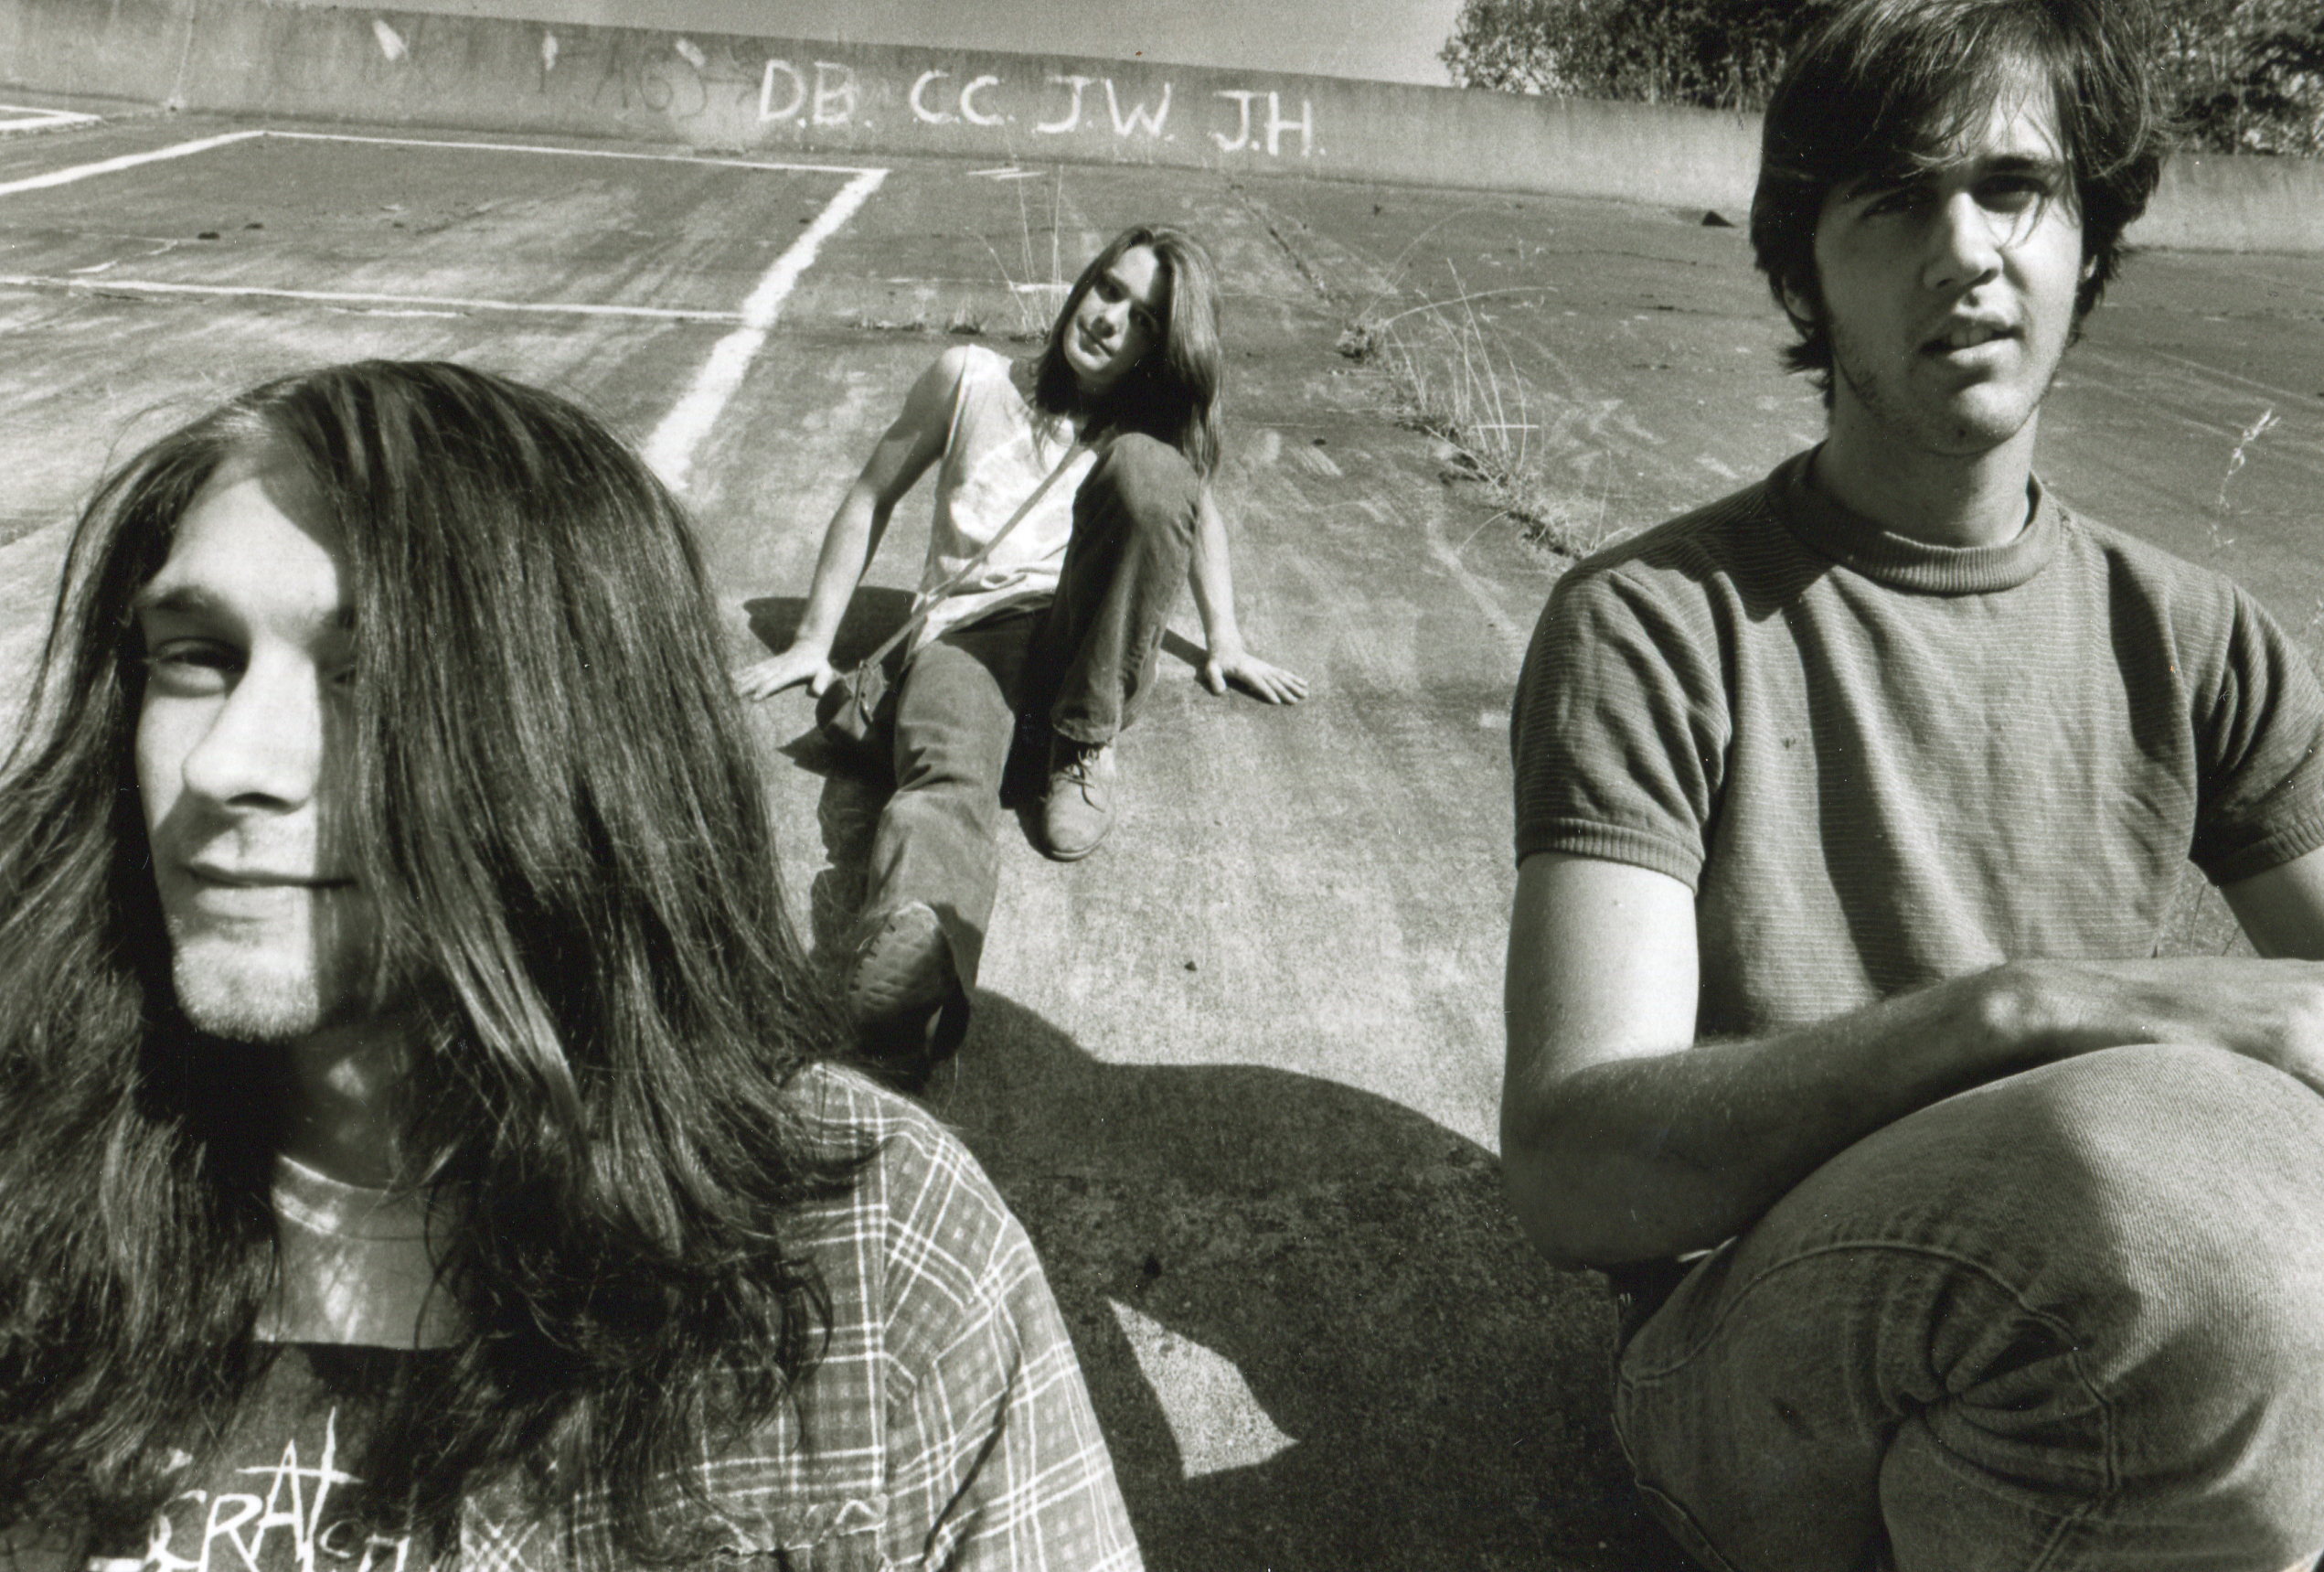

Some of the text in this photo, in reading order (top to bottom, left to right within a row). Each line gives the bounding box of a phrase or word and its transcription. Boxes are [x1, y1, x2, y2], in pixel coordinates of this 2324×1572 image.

[759, 59, 873, 129] D.B.
[1033, 75, 1176, 143] J.W.
[1209, 90, 1327, 157] J.H.
